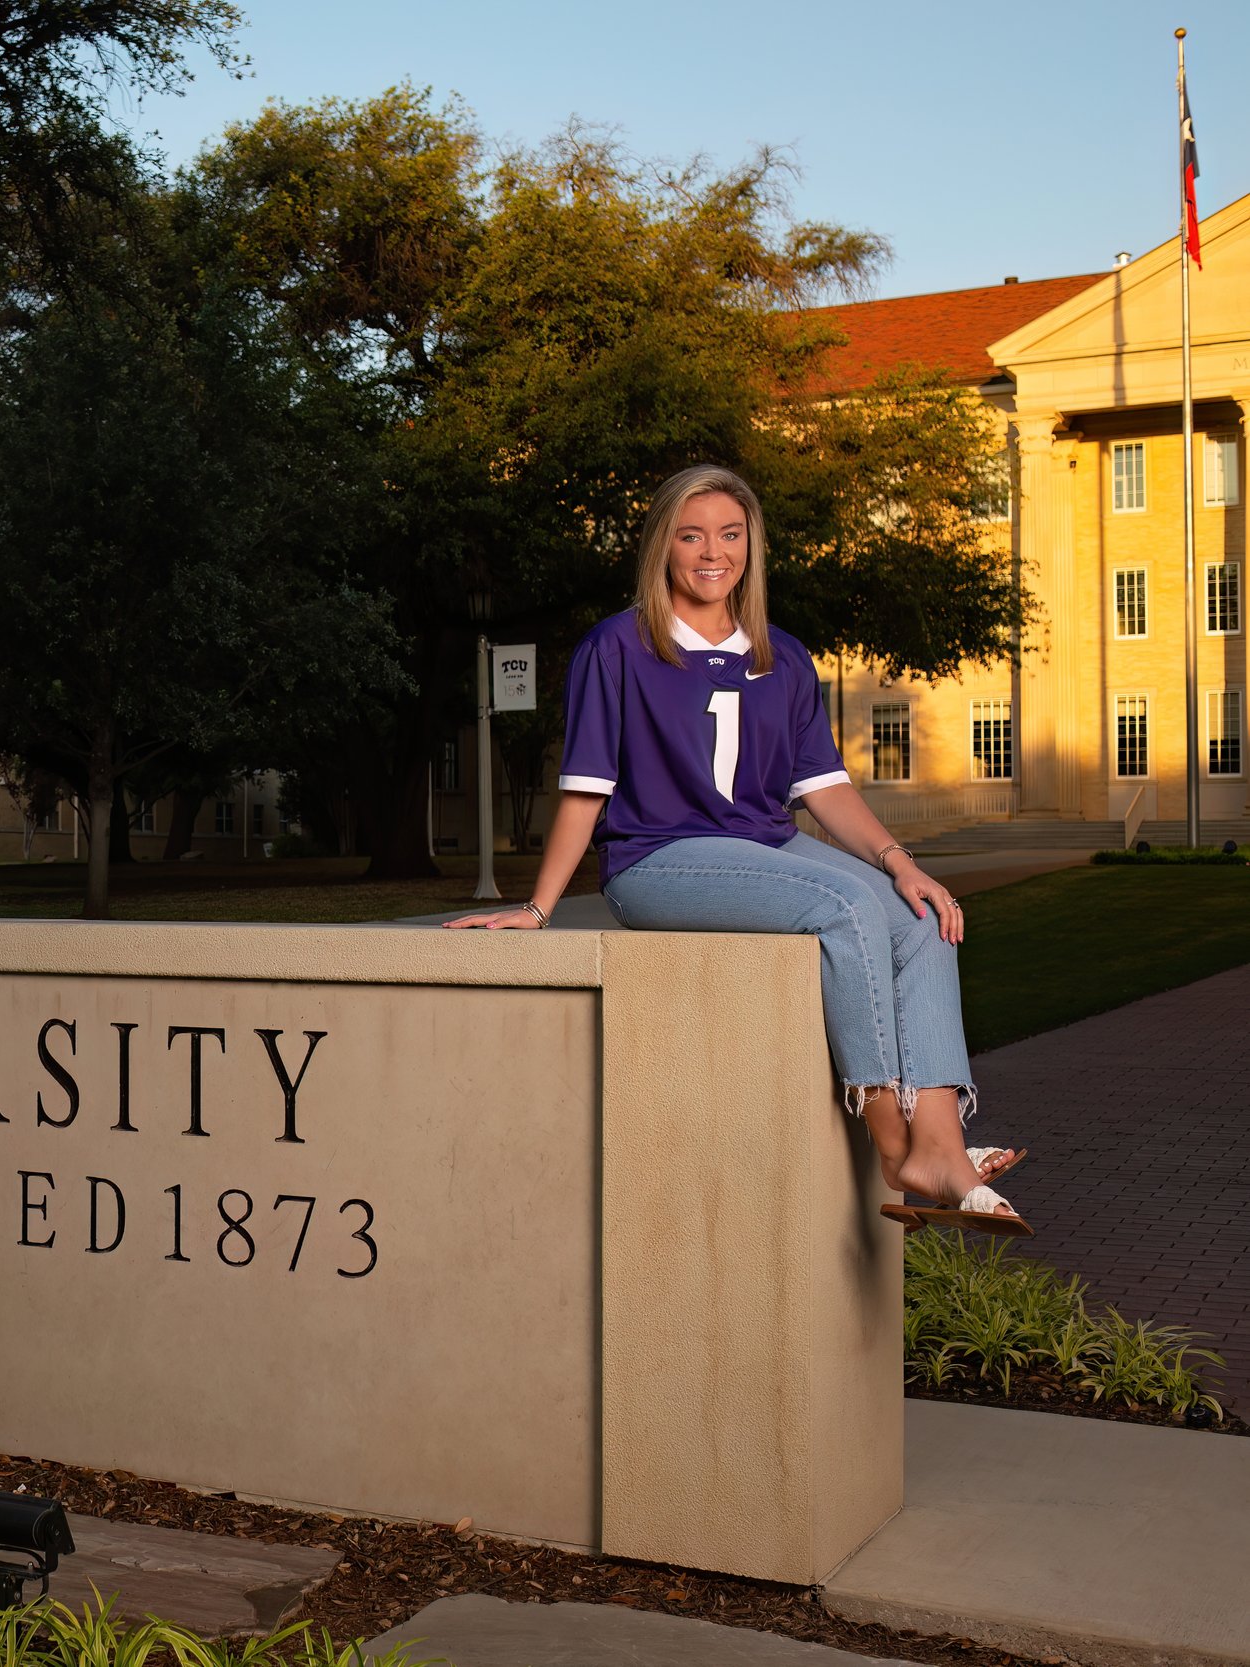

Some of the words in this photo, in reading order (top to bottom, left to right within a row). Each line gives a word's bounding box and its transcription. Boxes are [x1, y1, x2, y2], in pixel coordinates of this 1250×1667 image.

[501, 659, 528, 674] TCU
[708, 657, 726, 666] TCU
[706, 688, 740, 805] 1
[162, 1183, 379, 1279] 1873
